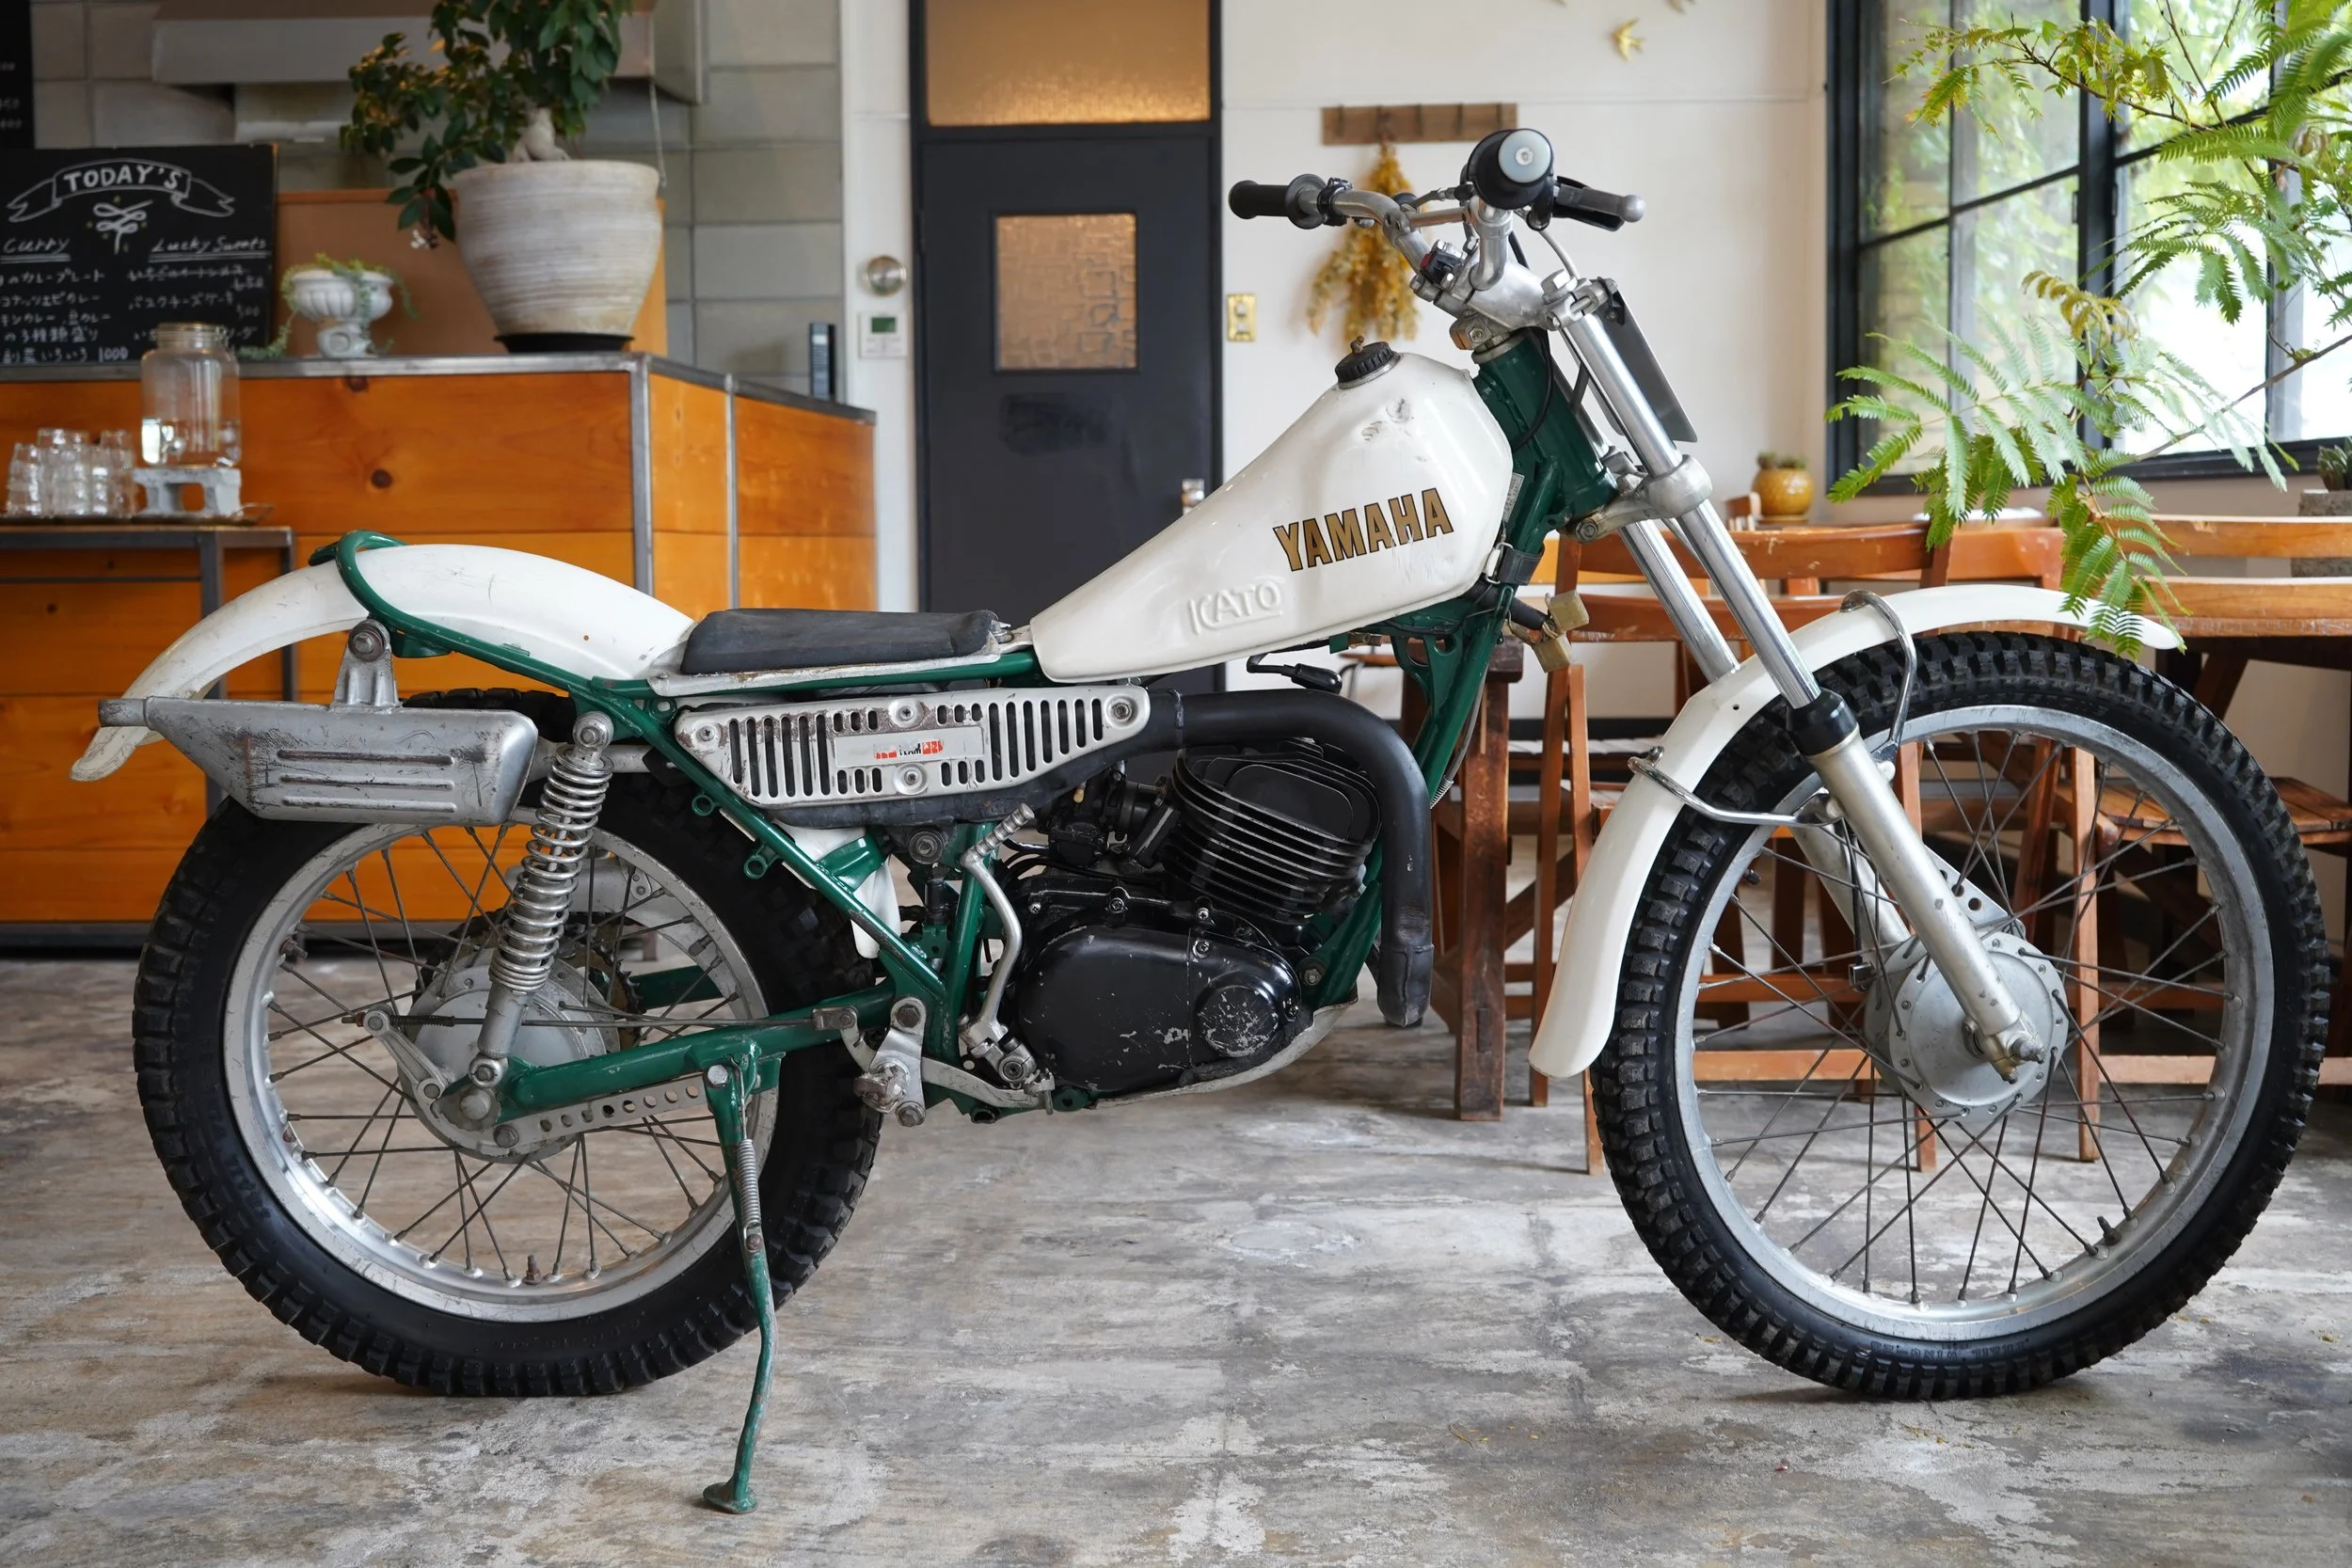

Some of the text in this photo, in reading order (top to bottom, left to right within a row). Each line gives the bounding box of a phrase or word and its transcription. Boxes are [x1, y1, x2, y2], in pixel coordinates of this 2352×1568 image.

[63, 165, 183, 192] TODAY'S
[4, 237, 71, 255] Curry
[151, 237, 211, 253] Lucky
[98, 345, 129, 363] 1000
[1273, 487, 1454, 572] YAMAHA
